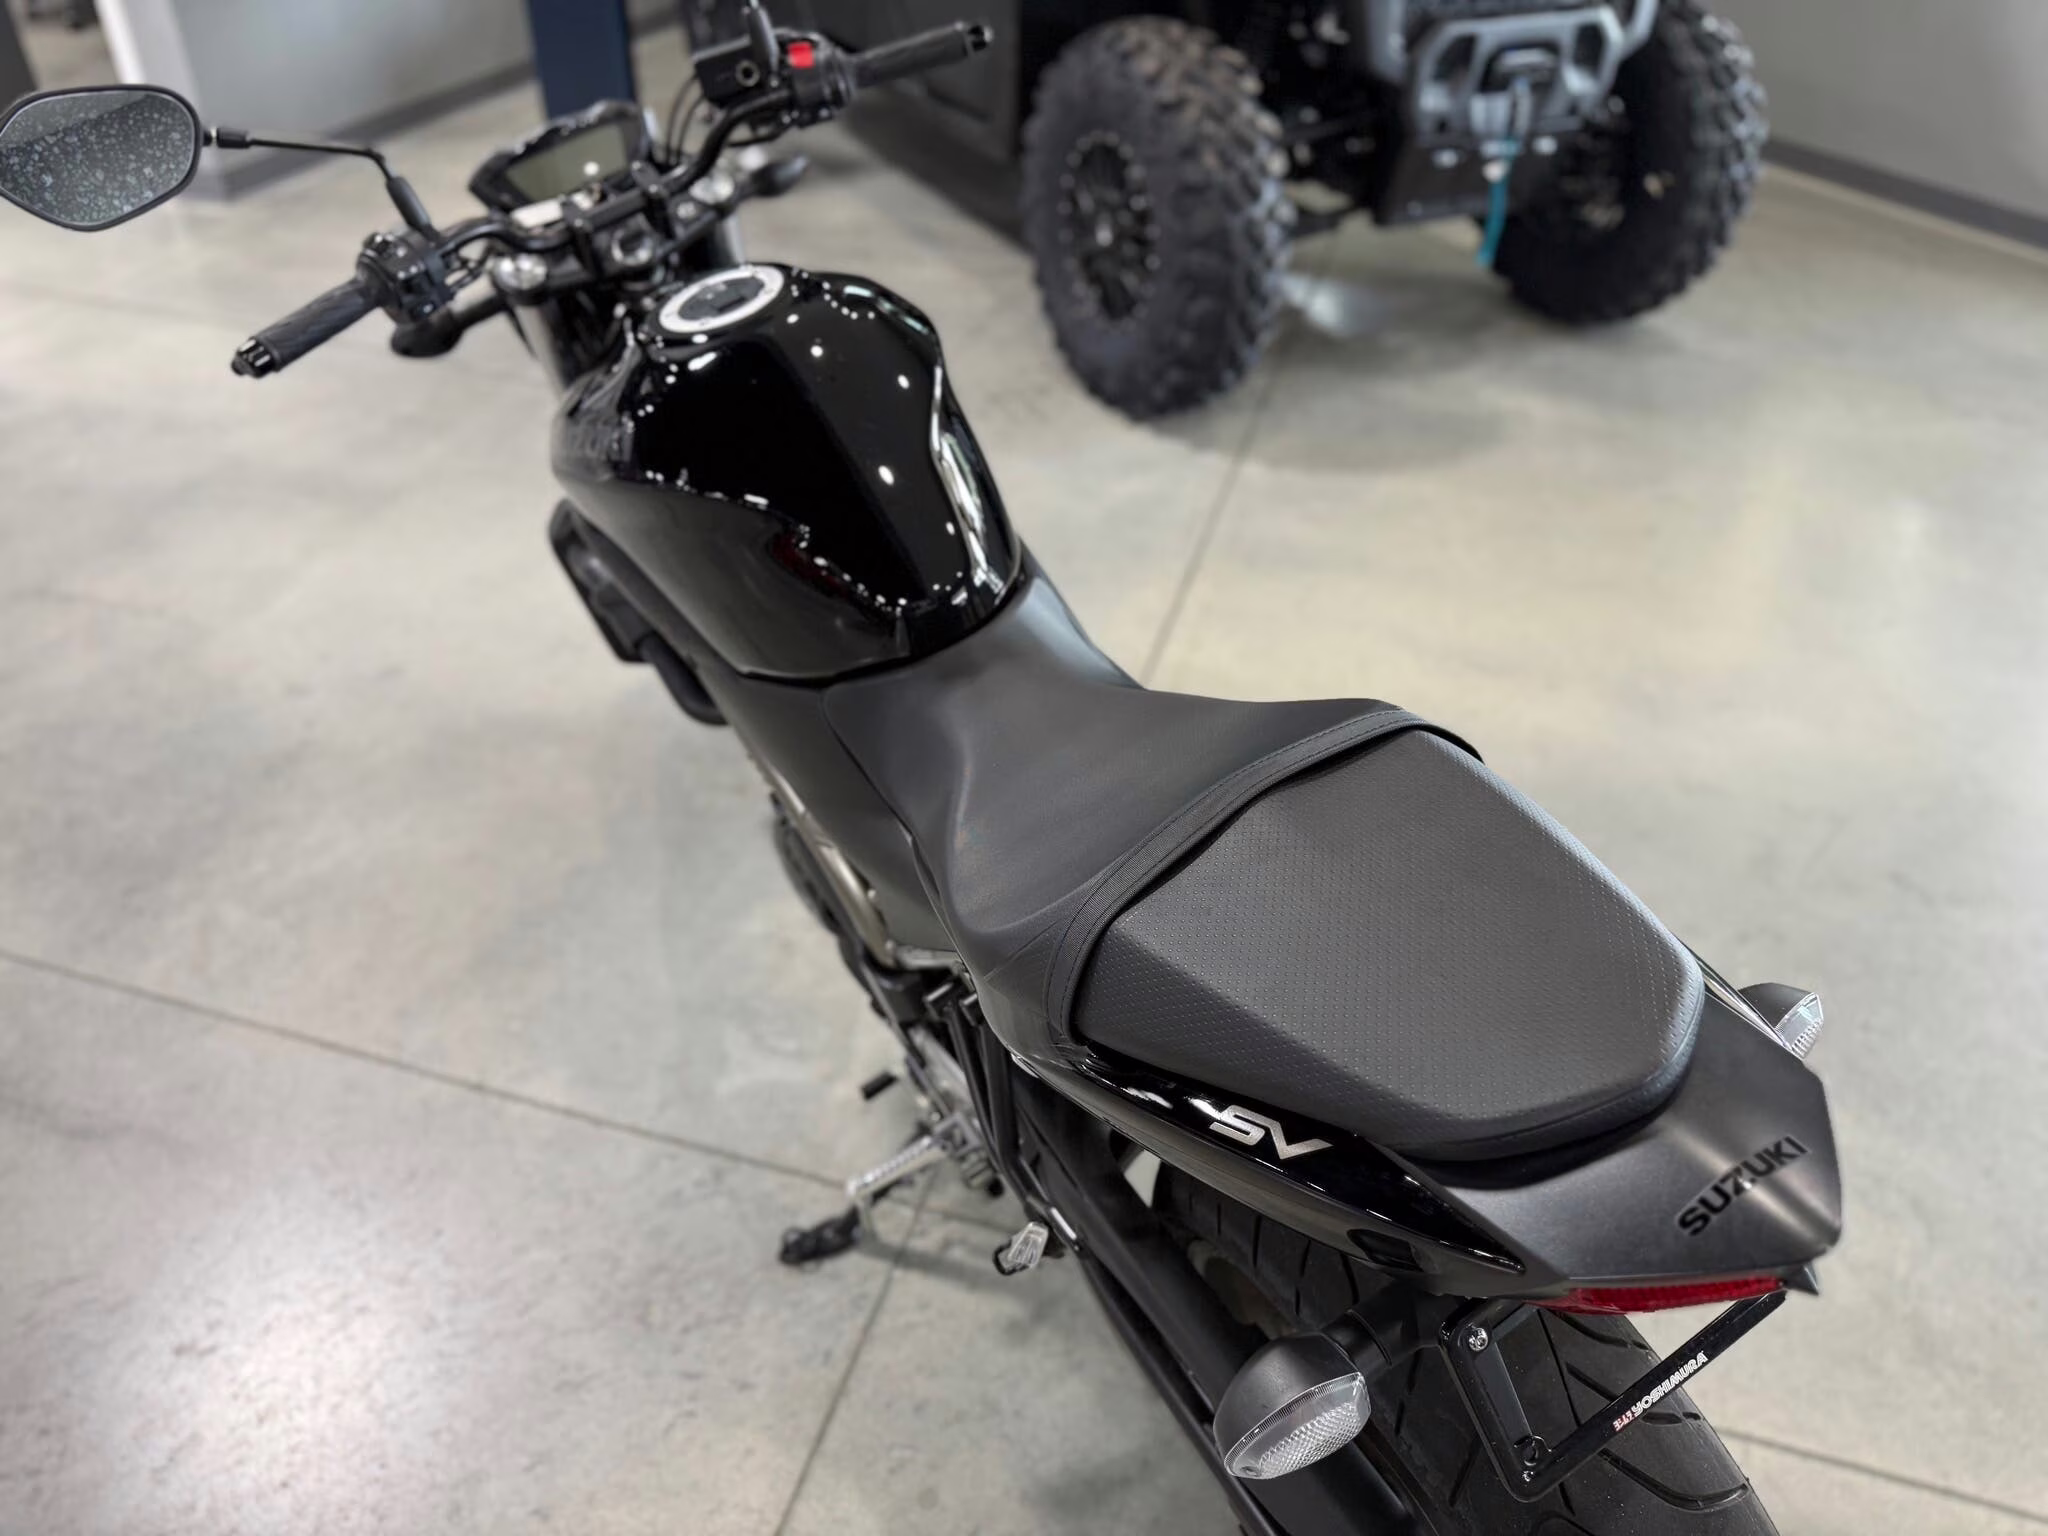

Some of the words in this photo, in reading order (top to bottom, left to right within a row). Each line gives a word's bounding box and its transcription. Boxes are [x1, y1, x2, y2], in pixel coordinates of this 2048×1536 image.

[1209, 1105, 1334, 1160] SV
[1677, 1136, 1808, 1236] SUZUKI
[1631, 1352, 1709, 1417] YOSHIMURA
